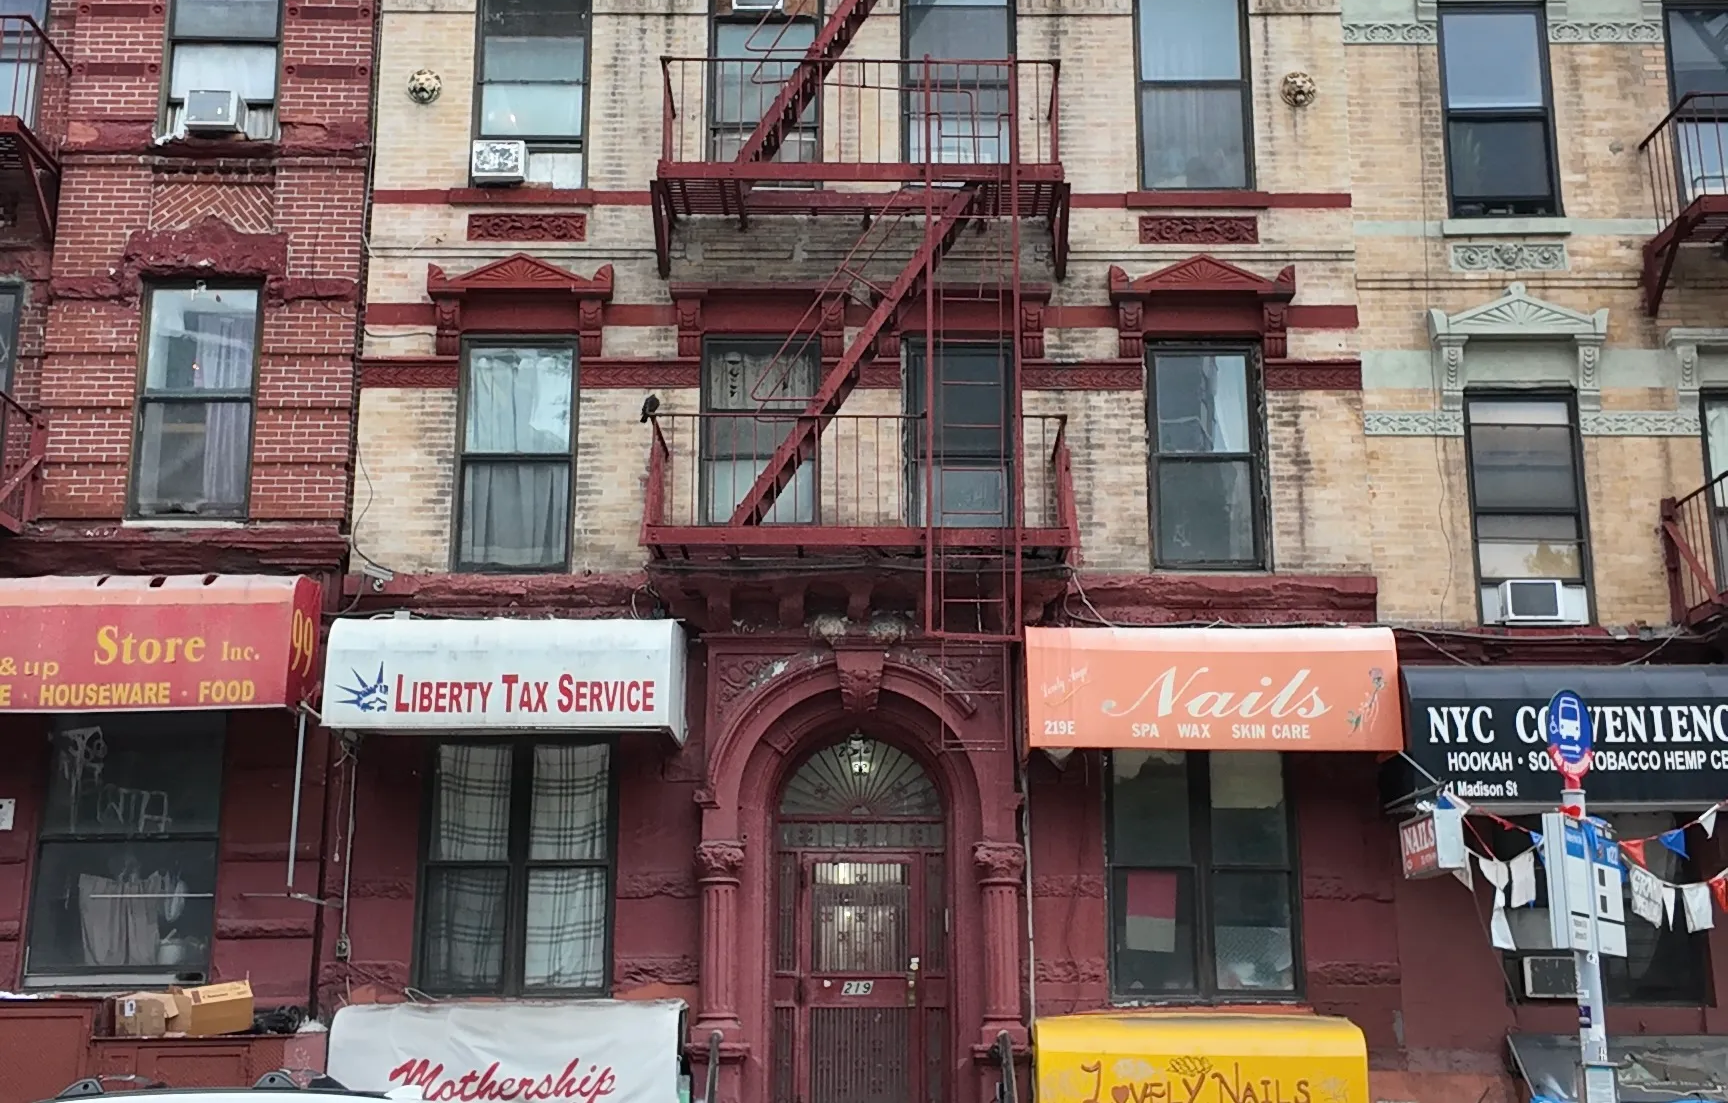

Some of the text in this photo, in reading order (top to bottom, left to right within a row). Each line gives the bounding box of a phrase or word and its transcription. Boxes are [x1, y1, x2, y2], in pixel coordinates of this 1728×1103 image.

[94, 625, 260, 665] Store Inc.
[24, 661, 60, 680] up
[39, 682, 171, 706] HOUSEWARE
[199, 680, 255, 703] FOOD
[395, 674, 655, 713] LIBERTY TAX SERVICE
[1102, 666, 1333, 718] Nails
[1044, 720, 1076, 735] 219E
[1132, 723, 1311, 739] SPA WAX SKIN CARE
[1427, 706, 1495, 744] NYC
[1448, 751, 1513, 772] HOOKAH
[1664, 750, 1707, 771] HEMP
[1457, 781, 1504, 796] Madison
[1505, 780, 1518, 797] St
[1402, 817, 1436, 856] NAILS
[844, 982, 871, 994] 219
[389, 1057, 616, 1103] Mothership
